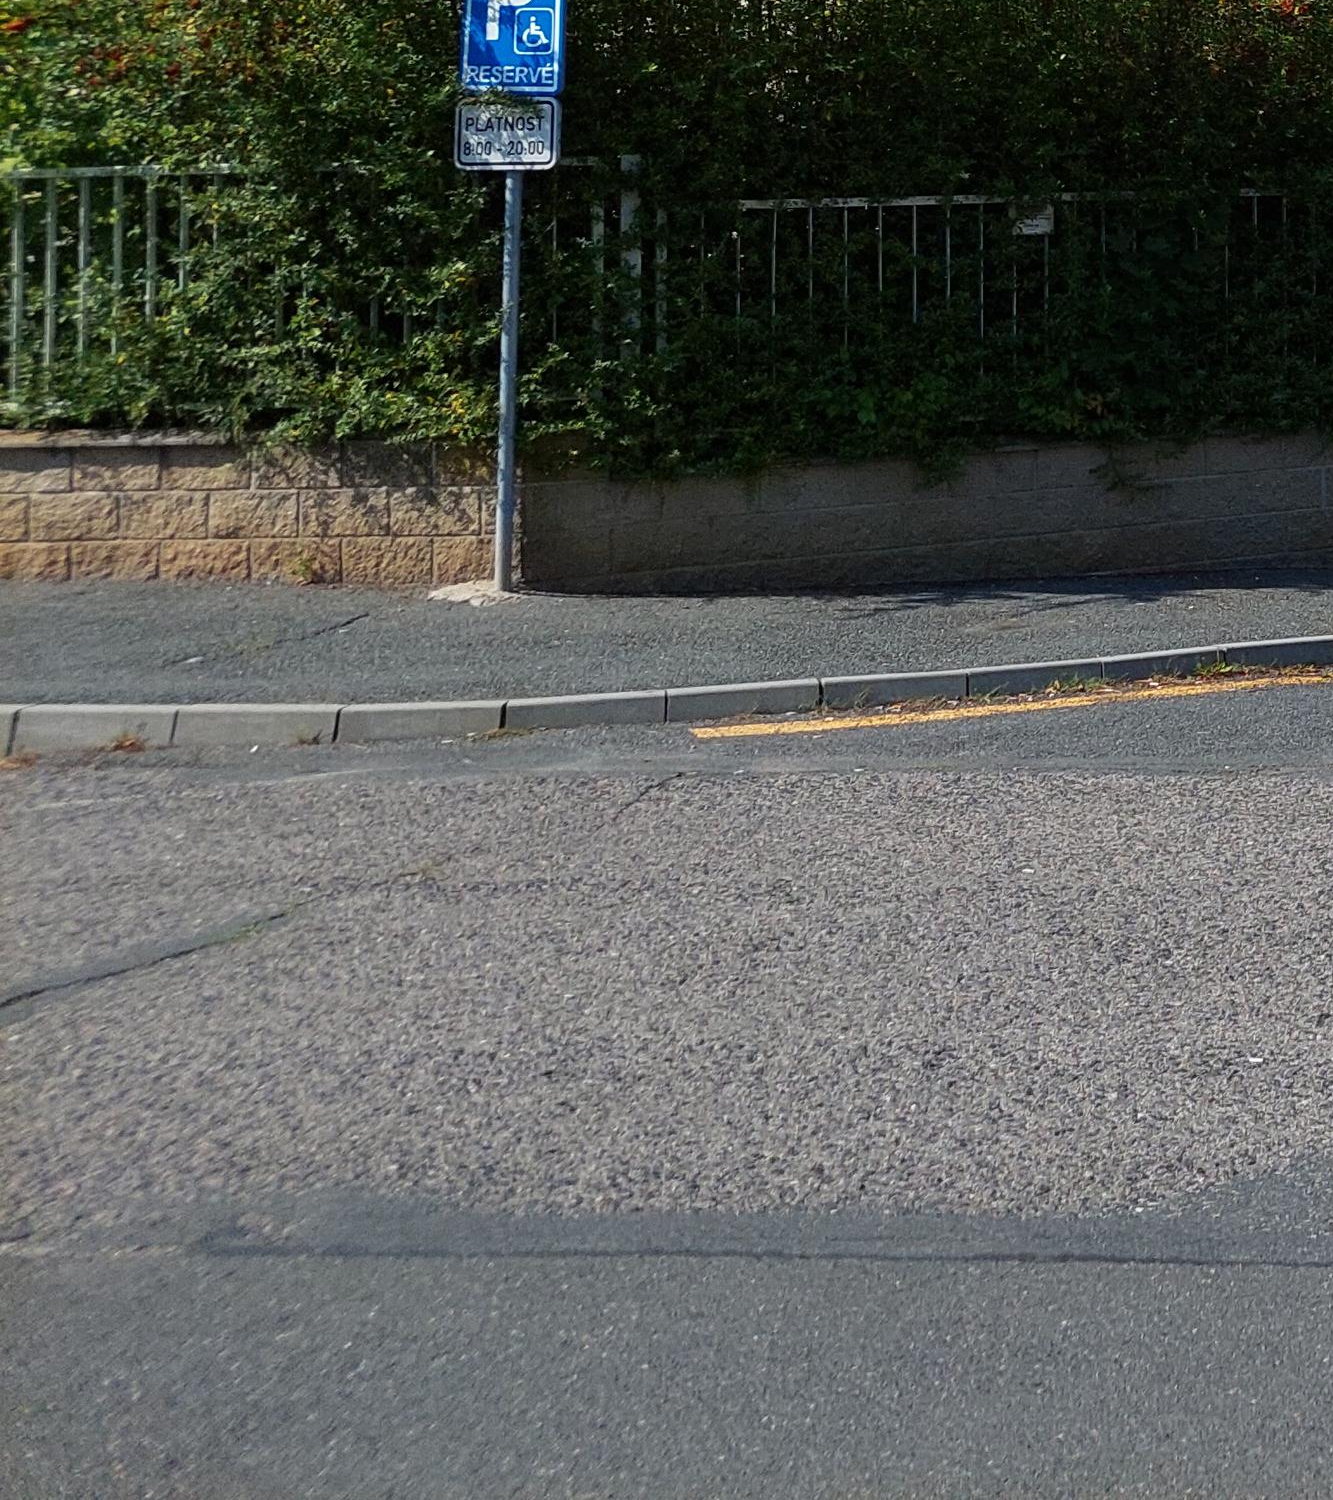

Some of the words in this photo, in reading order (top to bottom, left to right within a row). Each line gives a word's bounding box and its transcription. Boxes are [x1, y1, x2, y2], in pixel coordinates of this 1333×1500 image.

[466, 63, 553, 83] RESERVÉ
[465, 116, 545, 132] PLATNOST
[463, 140, 492, 156] 8:00
[506, 140, 545, 155] 20:00
